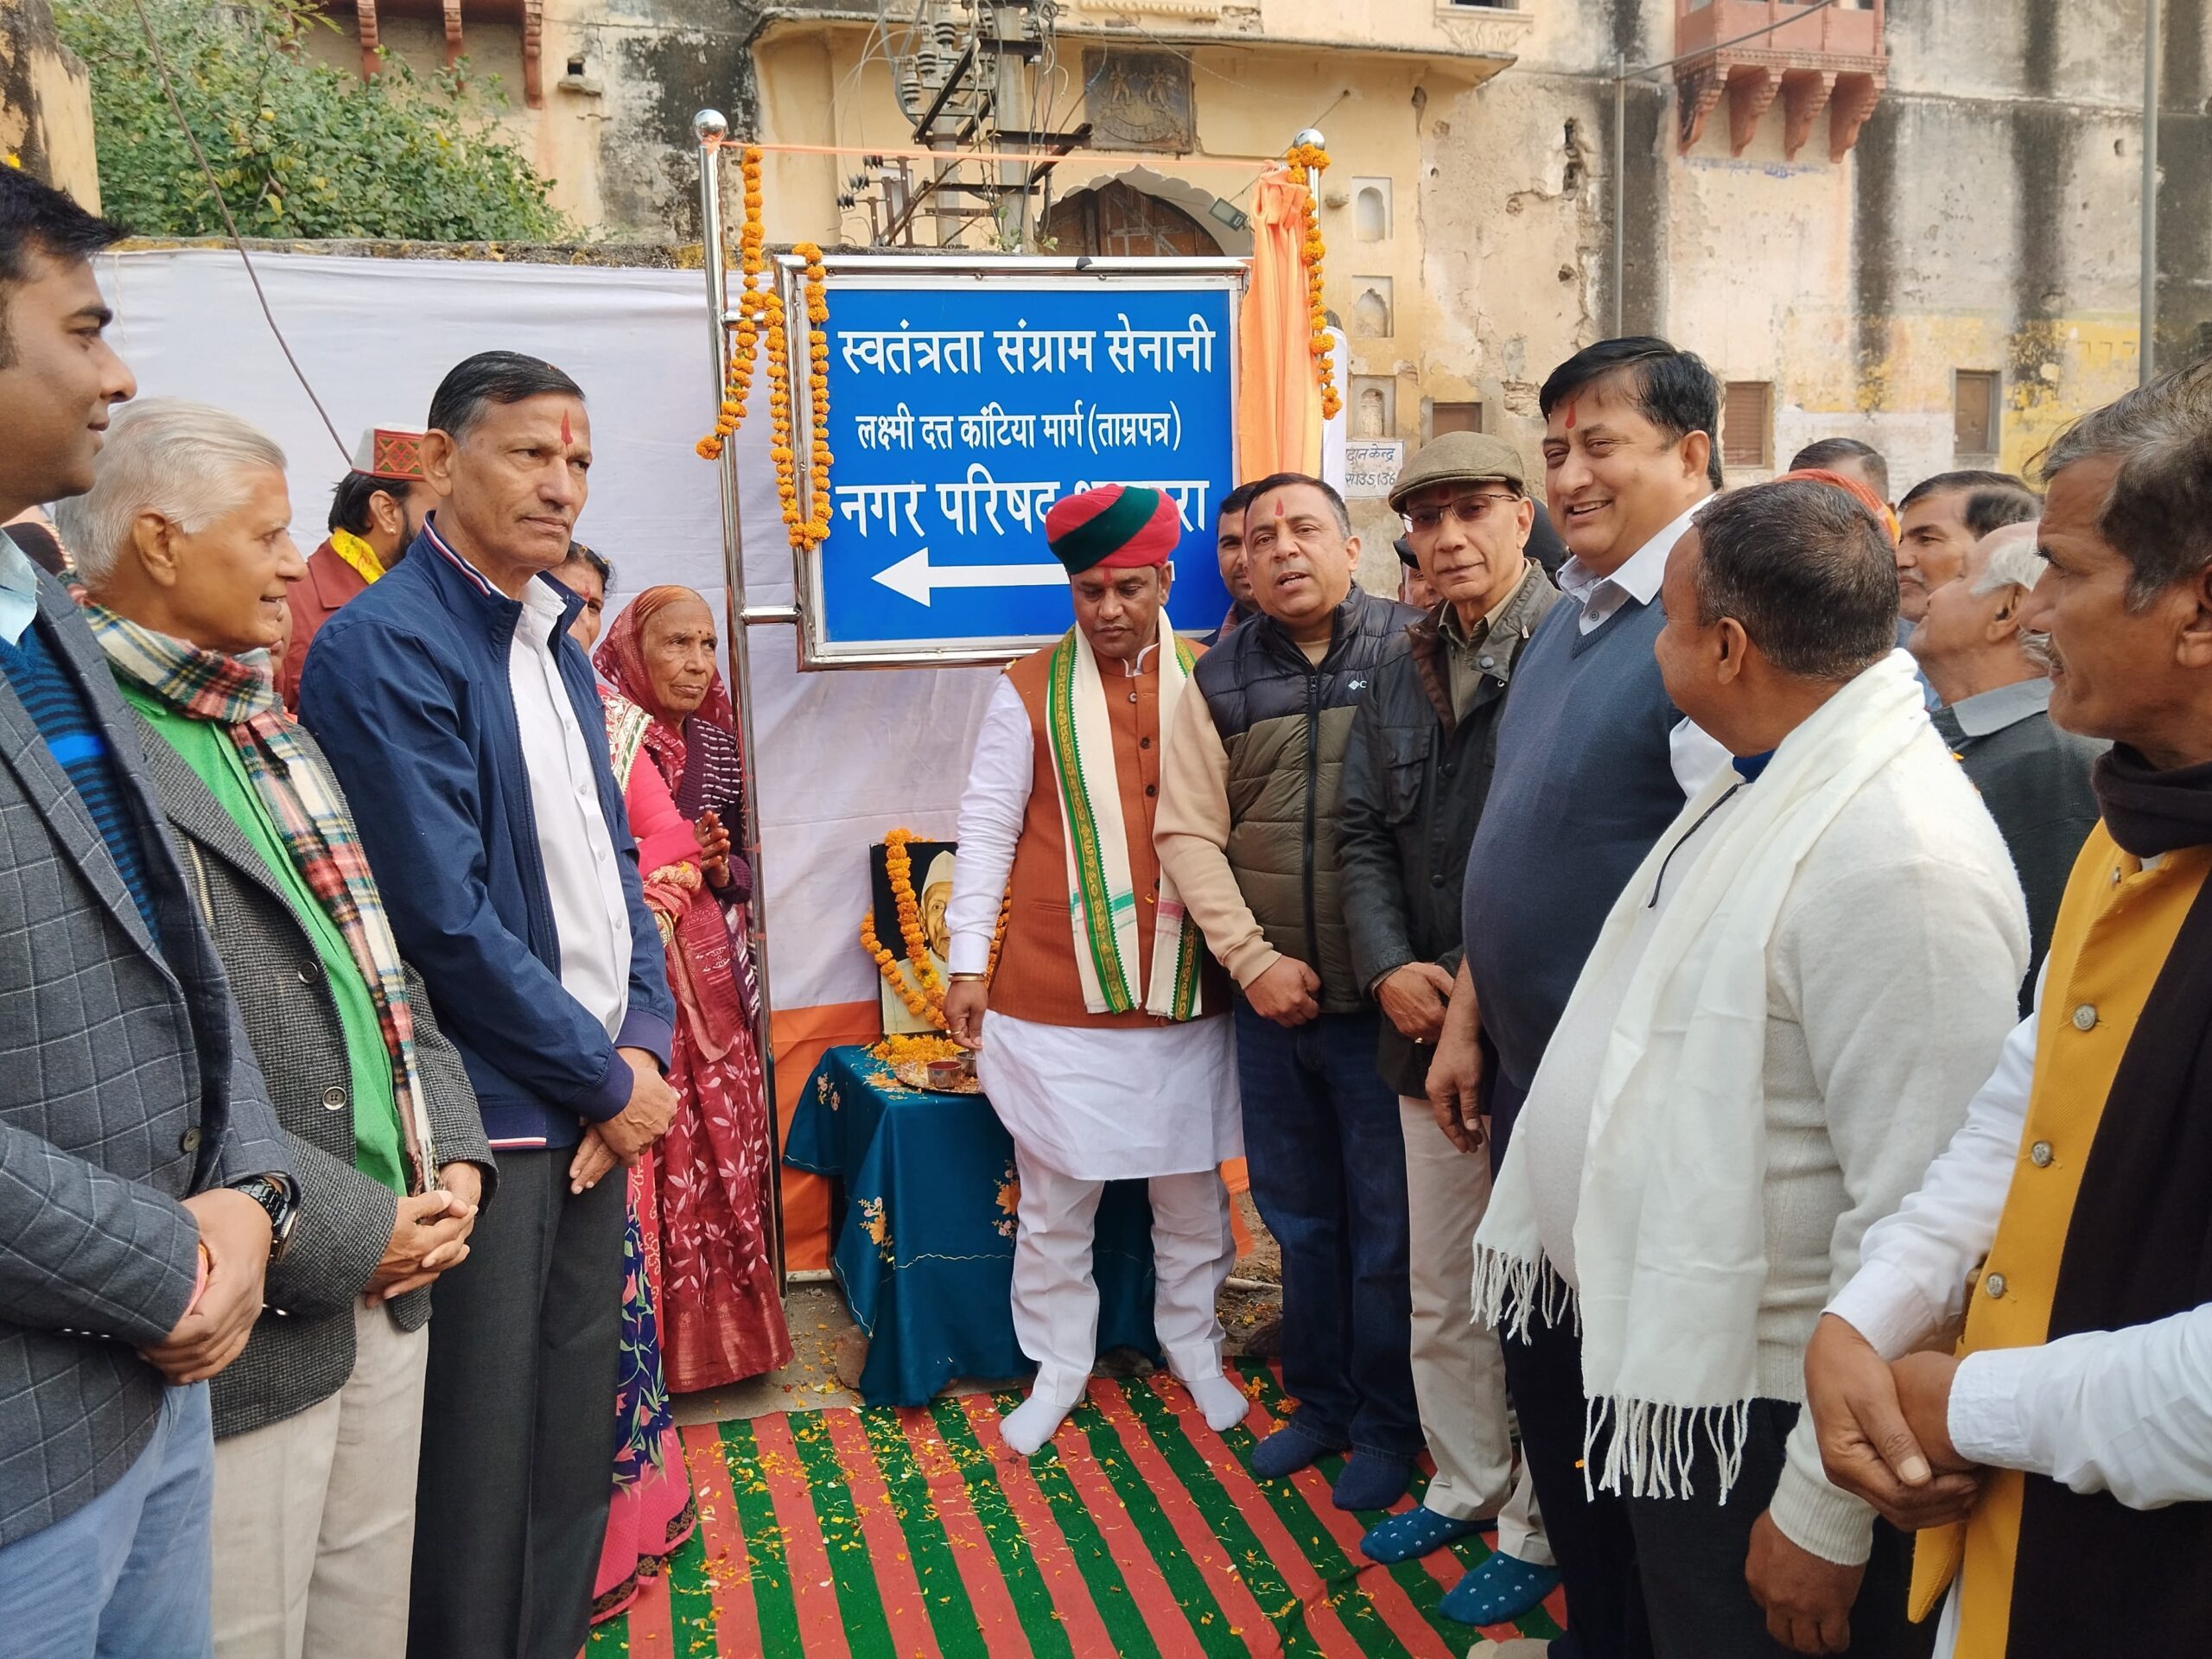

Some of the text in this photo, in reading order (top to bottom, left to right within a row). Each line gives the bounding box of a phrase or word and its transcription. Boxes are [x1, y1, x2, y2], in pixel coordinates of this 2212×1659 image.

[837, 313, 1217, 374] स्वतंत्रता संग्राम सेनानी
[855, 399, 1182, 455] लक्ष्मी दत्त कांटिया मार्ग (ताम्रपत्र)
[835, 484, 927, 537] नगर
